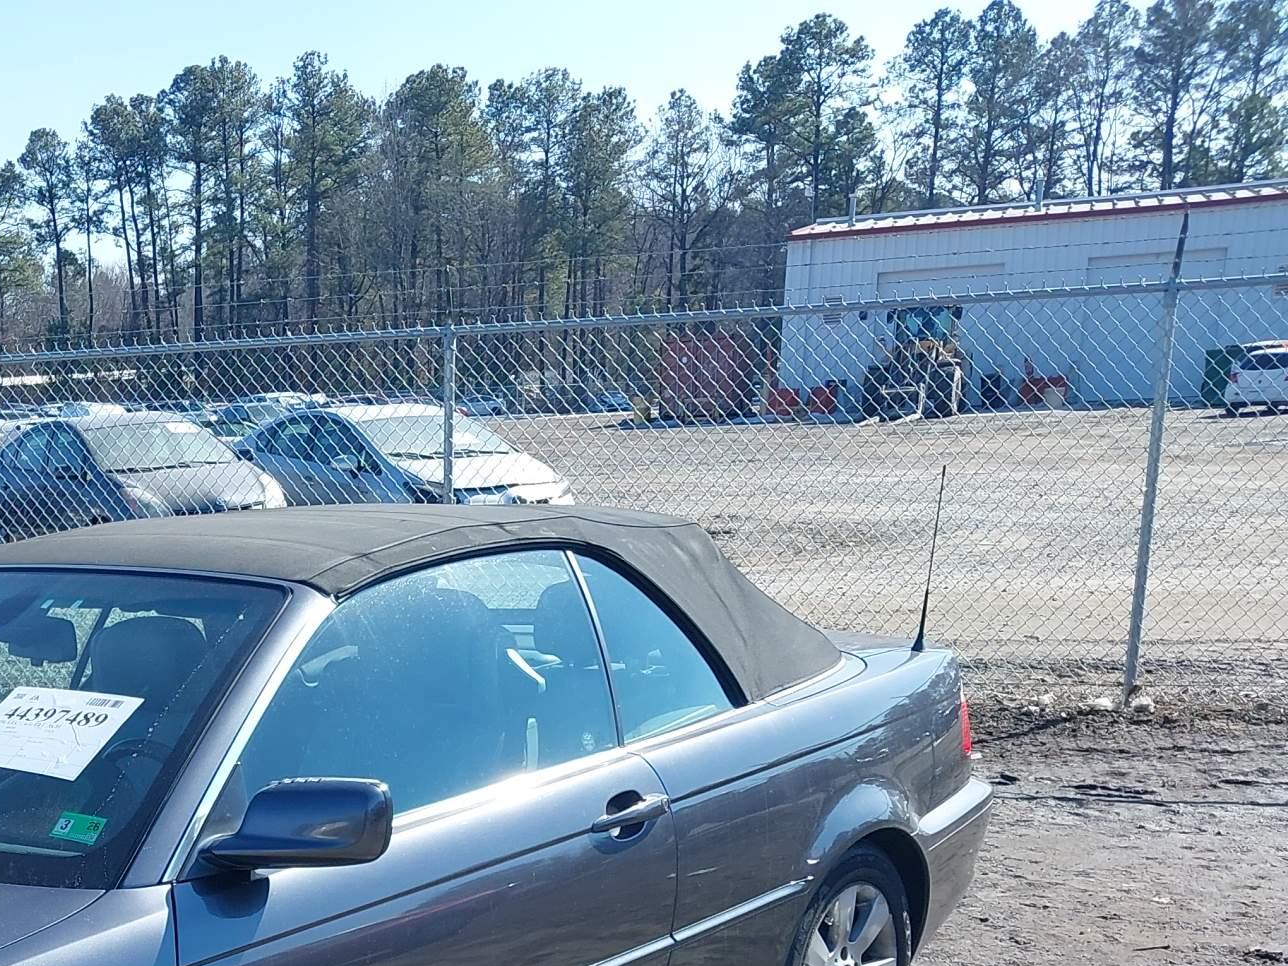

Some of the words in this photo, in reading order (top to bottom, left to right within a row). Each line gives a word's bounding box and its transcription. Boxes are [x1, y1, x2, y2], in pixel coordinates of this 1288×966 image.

[4, 705, 109, 728] 44397489
[59, 819, 72, 831] 3
[86, 821, 101, 832] 26
